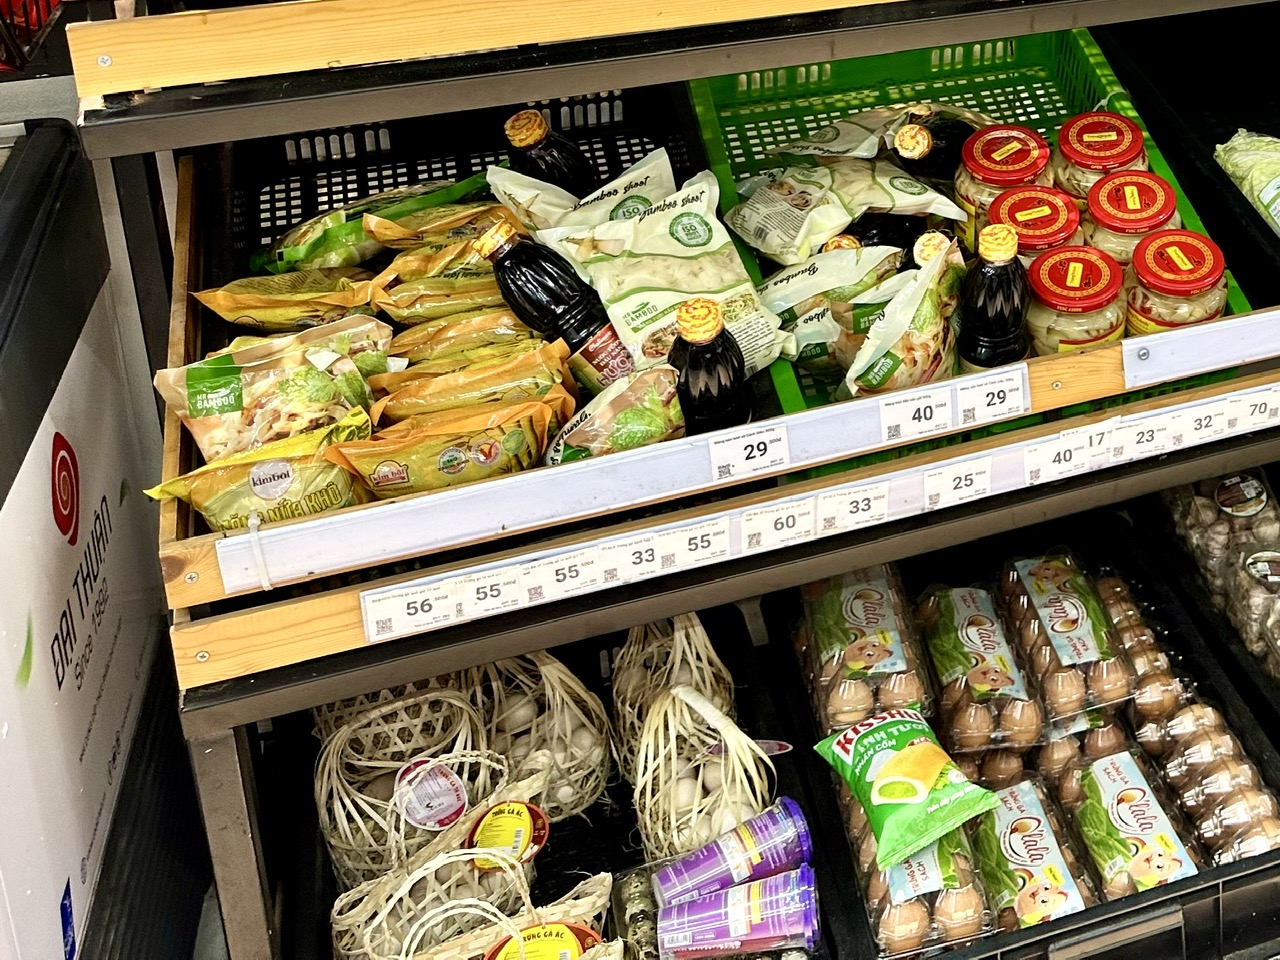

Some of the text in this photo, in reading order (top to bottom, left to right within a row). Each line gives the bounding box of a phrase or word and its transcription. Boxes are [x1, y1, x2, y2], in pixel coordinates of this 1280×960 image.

[622, 207, 640, 217] ISO
[985, 390, 1007, 407] 29
[912, 405, 933, 423] 40
[1249, 402, 1268, 416] 70
[1194, 415, 1213, 431] 32
[1089, 432, 1105, 448] 17
[1136, 429, 1154, 444] 23
[744, 441, 767, 461] 29
[1052, 449, 1072, 464] 40
[953, 473, 974, 490] 25
[849, 497, 871, 514] 33
[774, 515, 796, 531] 60
[688, 533, 711, 552] 55
[632, 548, 655, 565] 33
[555, 565, 580, 583] 55
[475, 583, 502, 601] 55
[406, 599, 433, 616] 56
